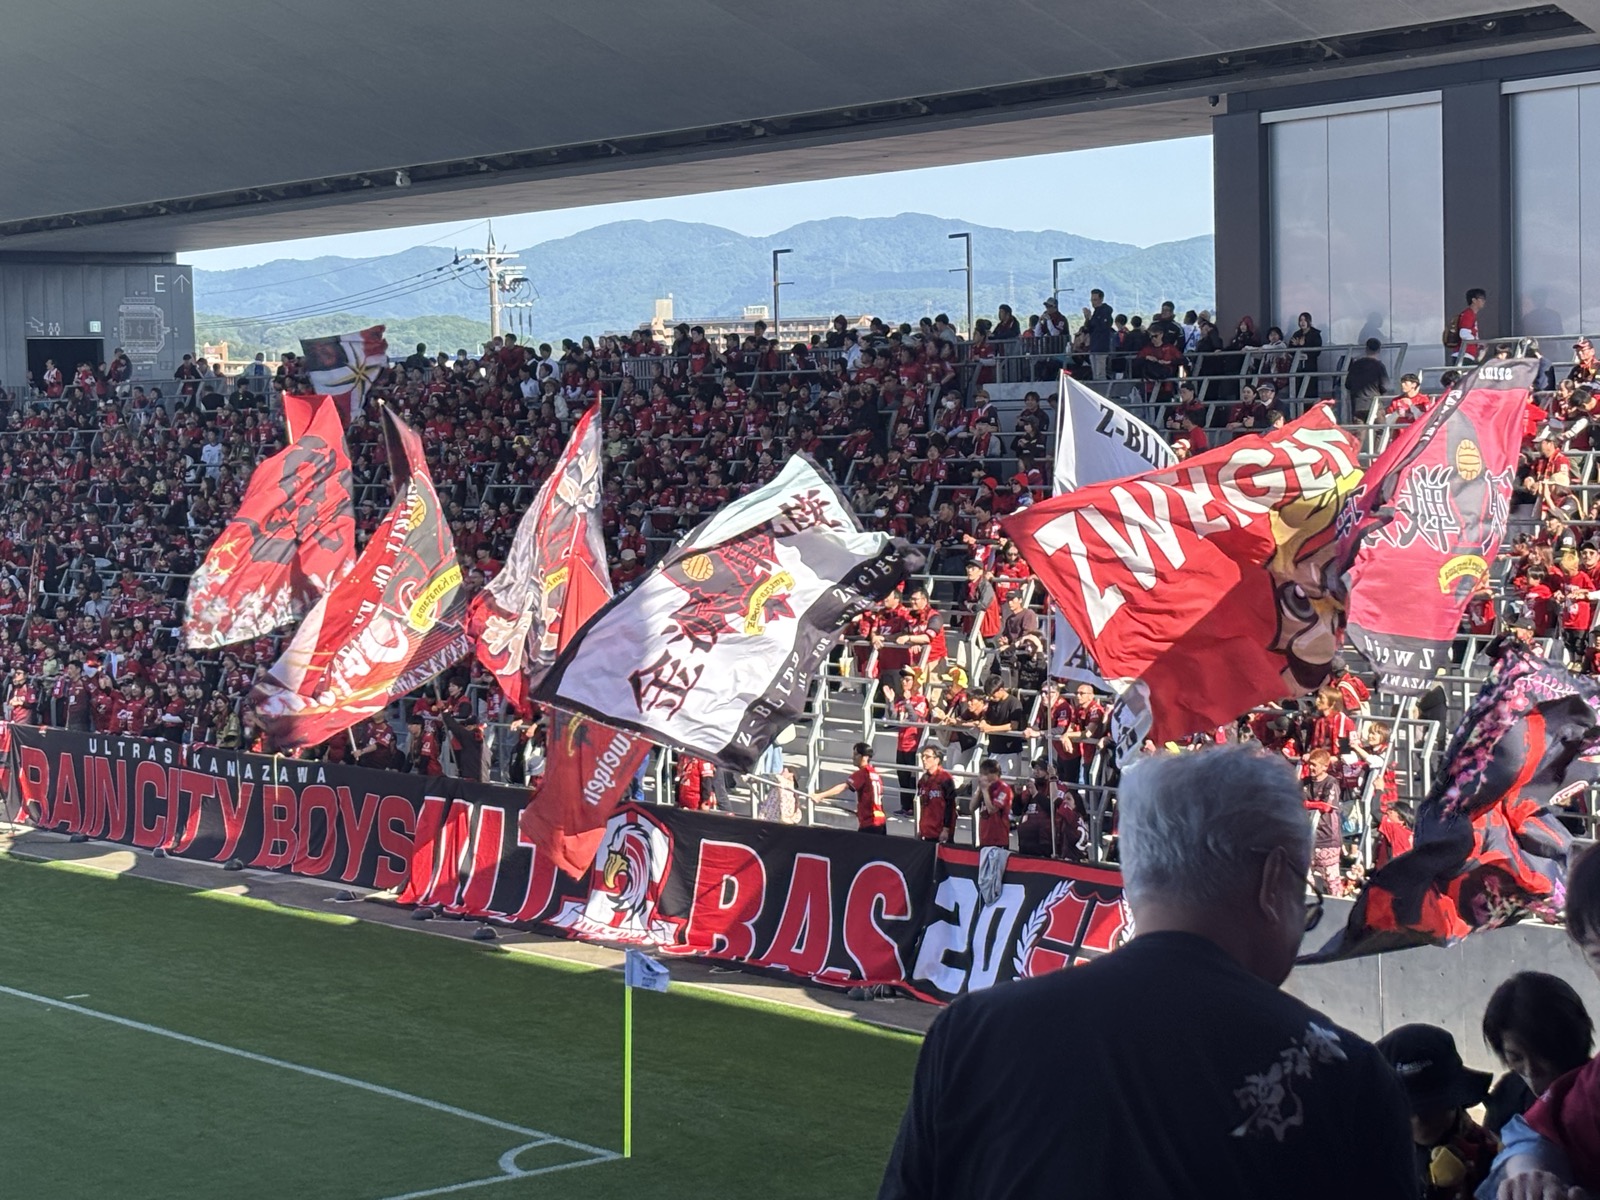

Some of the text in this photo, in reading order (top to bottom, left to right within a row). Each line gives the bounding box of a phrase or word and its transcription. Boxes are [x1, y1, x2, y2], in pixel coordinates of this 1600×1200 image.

[154, 274, 166, 293] E
[89, 738, 326, 784] ULTRAS KANAZAWA
[132, 761, 255, 862] CITY
[249, 785, 417, 888] BOYS
